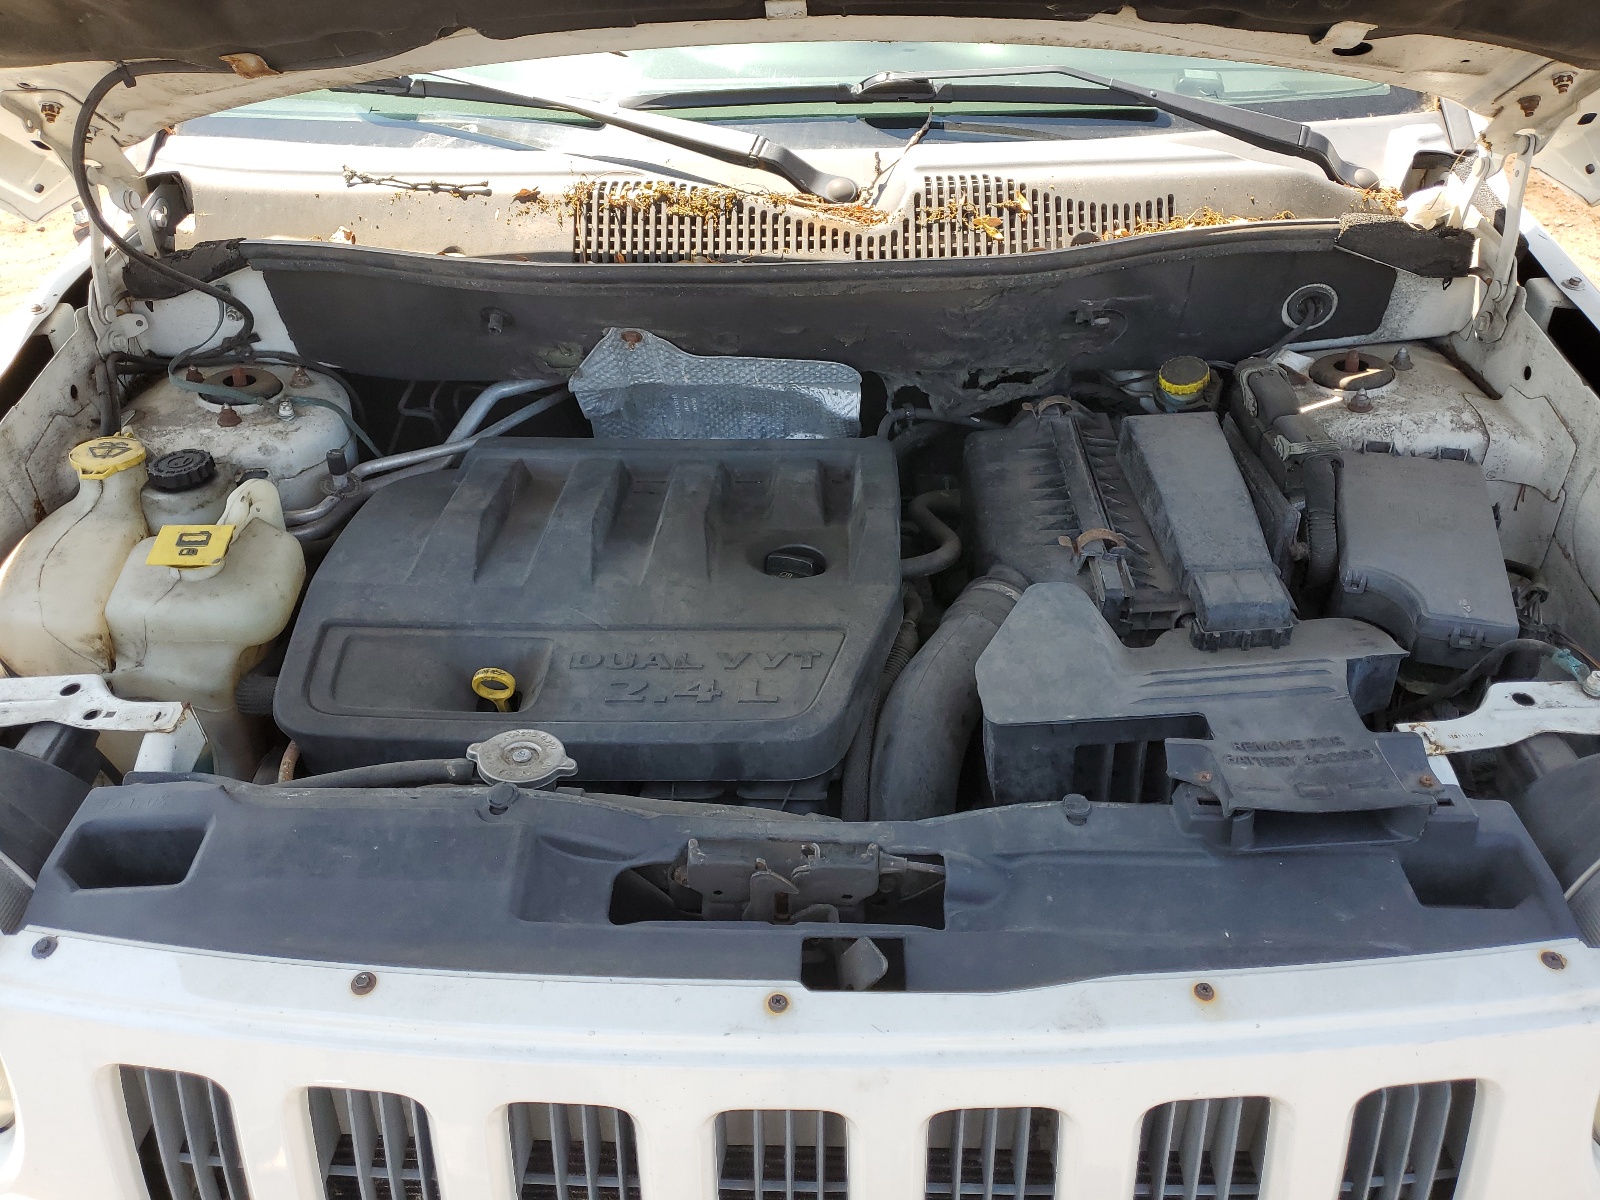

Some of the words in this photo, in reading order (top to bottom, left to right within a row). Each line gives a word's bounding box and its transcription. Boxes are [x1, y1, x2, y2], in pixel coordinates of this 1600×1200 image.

[568, 651, 704, 670] DUAL
[715, 650, 823, 670] VVT
[1232, 738, 1305, 752] REMOVE
